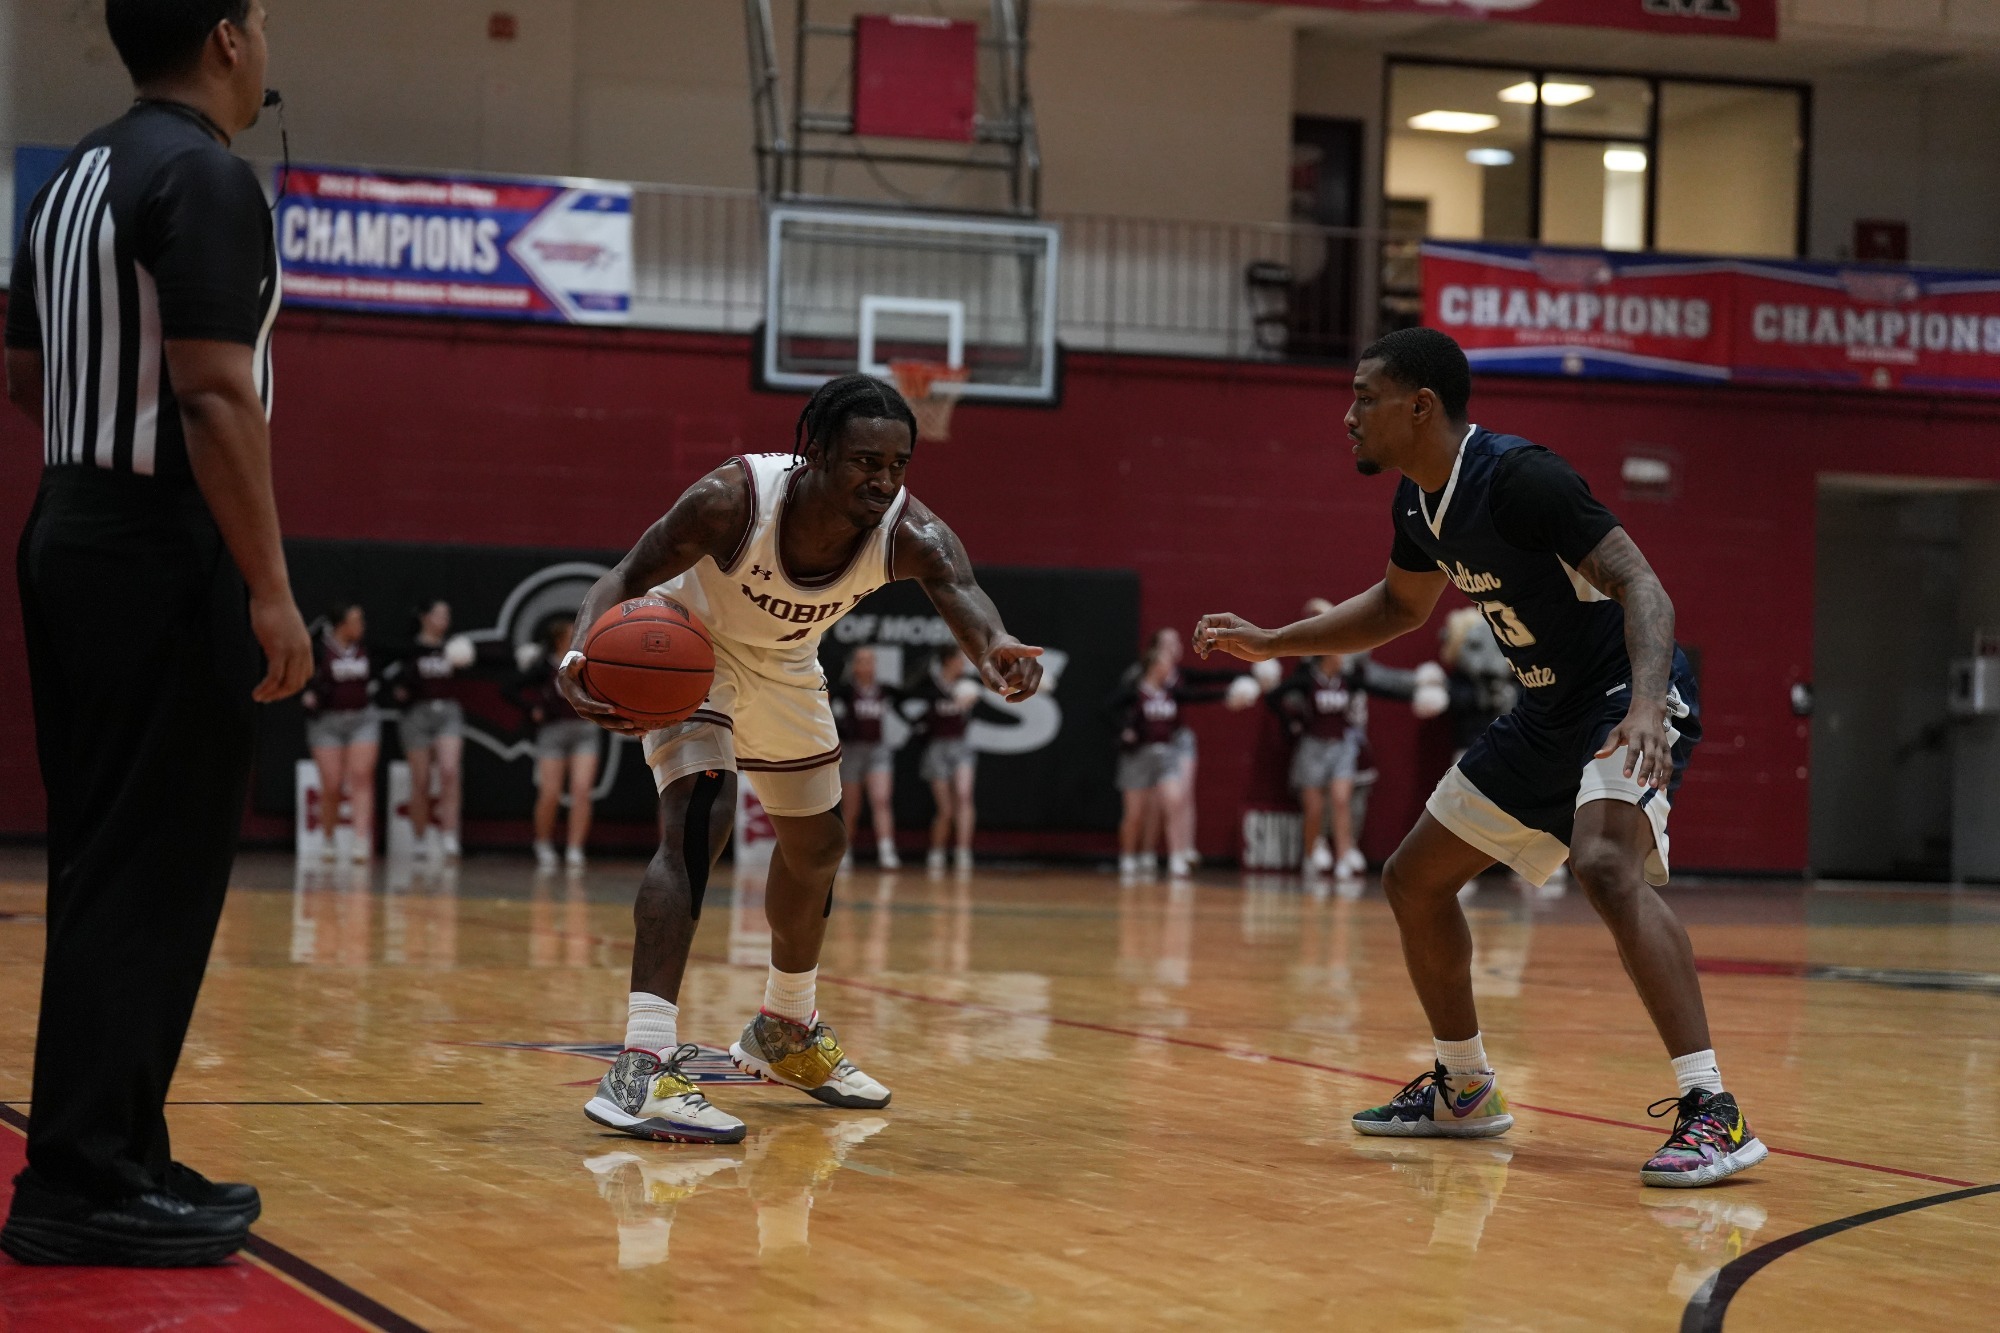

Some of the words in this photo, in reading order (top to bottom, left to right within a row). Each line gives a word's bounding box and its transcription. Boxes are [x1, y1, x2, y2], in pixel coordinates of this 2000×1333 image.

[282, 205, 500, 275] CHAMPIONS
[1439, 286, 1711, 339] CHAMPIONS
[705, 769, 719, 779] KT
